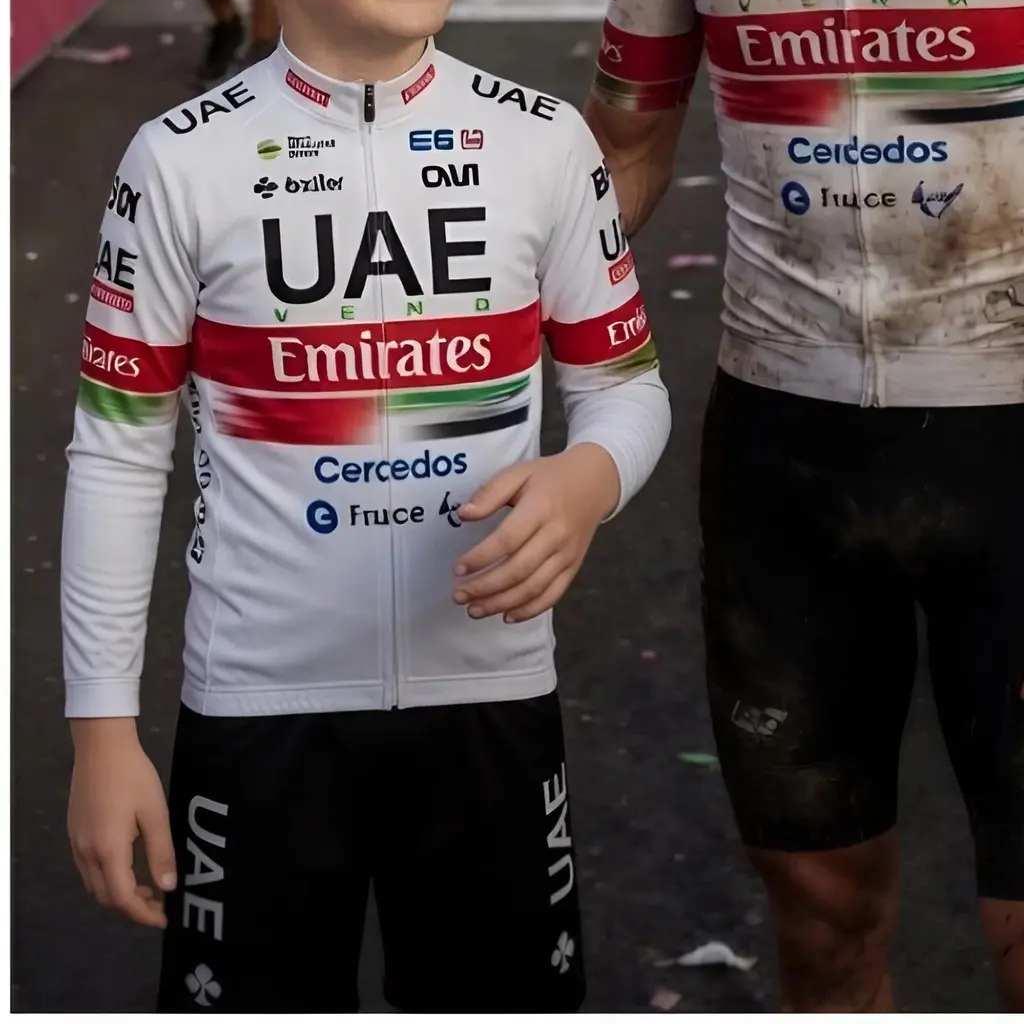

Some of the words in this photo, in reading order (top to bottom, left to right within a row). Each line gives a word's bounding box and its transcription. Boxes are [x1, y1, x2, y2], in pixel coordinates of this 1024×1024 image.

[736, 17, 976, 68] Emirates
[162, 81, 256, 134] UAE
[471, 74, 561, 121] UAE
[262, 206, 492, 304] UAE
[268, 330, 491, 383] Emirates
[543, 762, 575, 905] UAE
[182, 794, 229, 941] UAE
